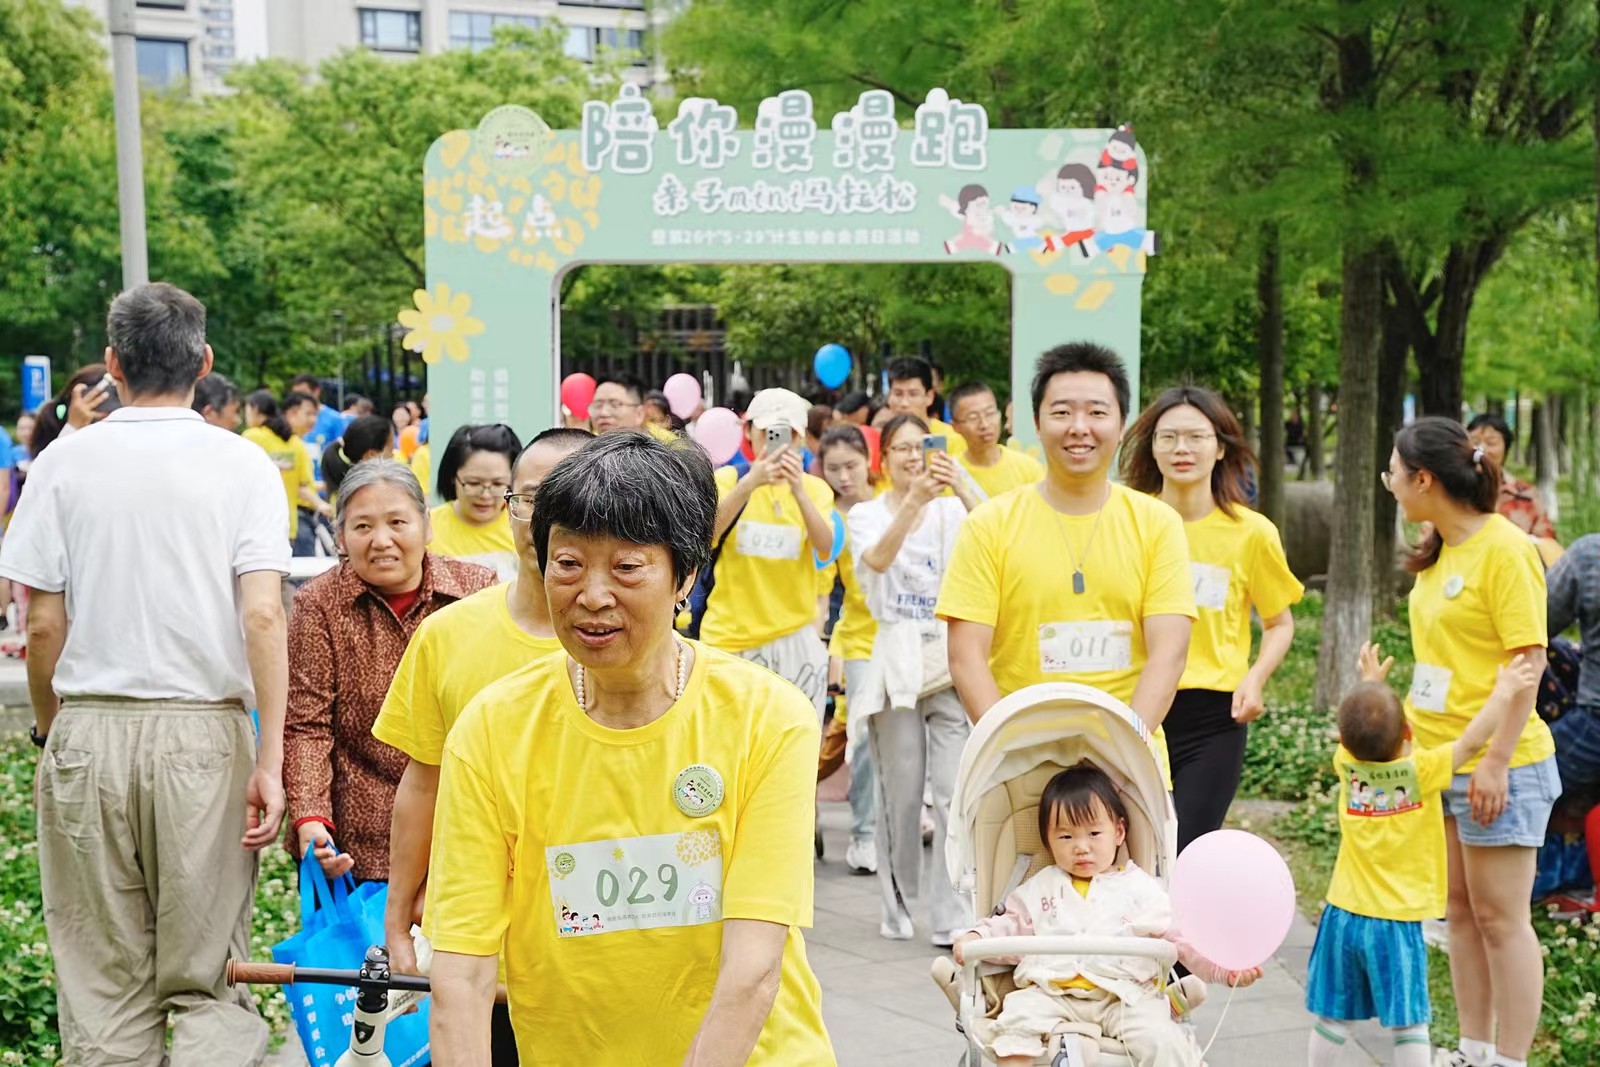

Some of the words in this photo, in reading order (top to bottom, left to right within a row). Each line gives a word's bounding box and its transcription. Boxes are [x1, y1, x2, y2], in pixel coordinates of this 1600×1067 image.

[580, 83, 989, 175] 陪你漫漫跑
[464, 193, 563, 241] 起点
[652, 172, 918, 215] 亲子mini马拉松
[595, 862, 679, 908] 029
